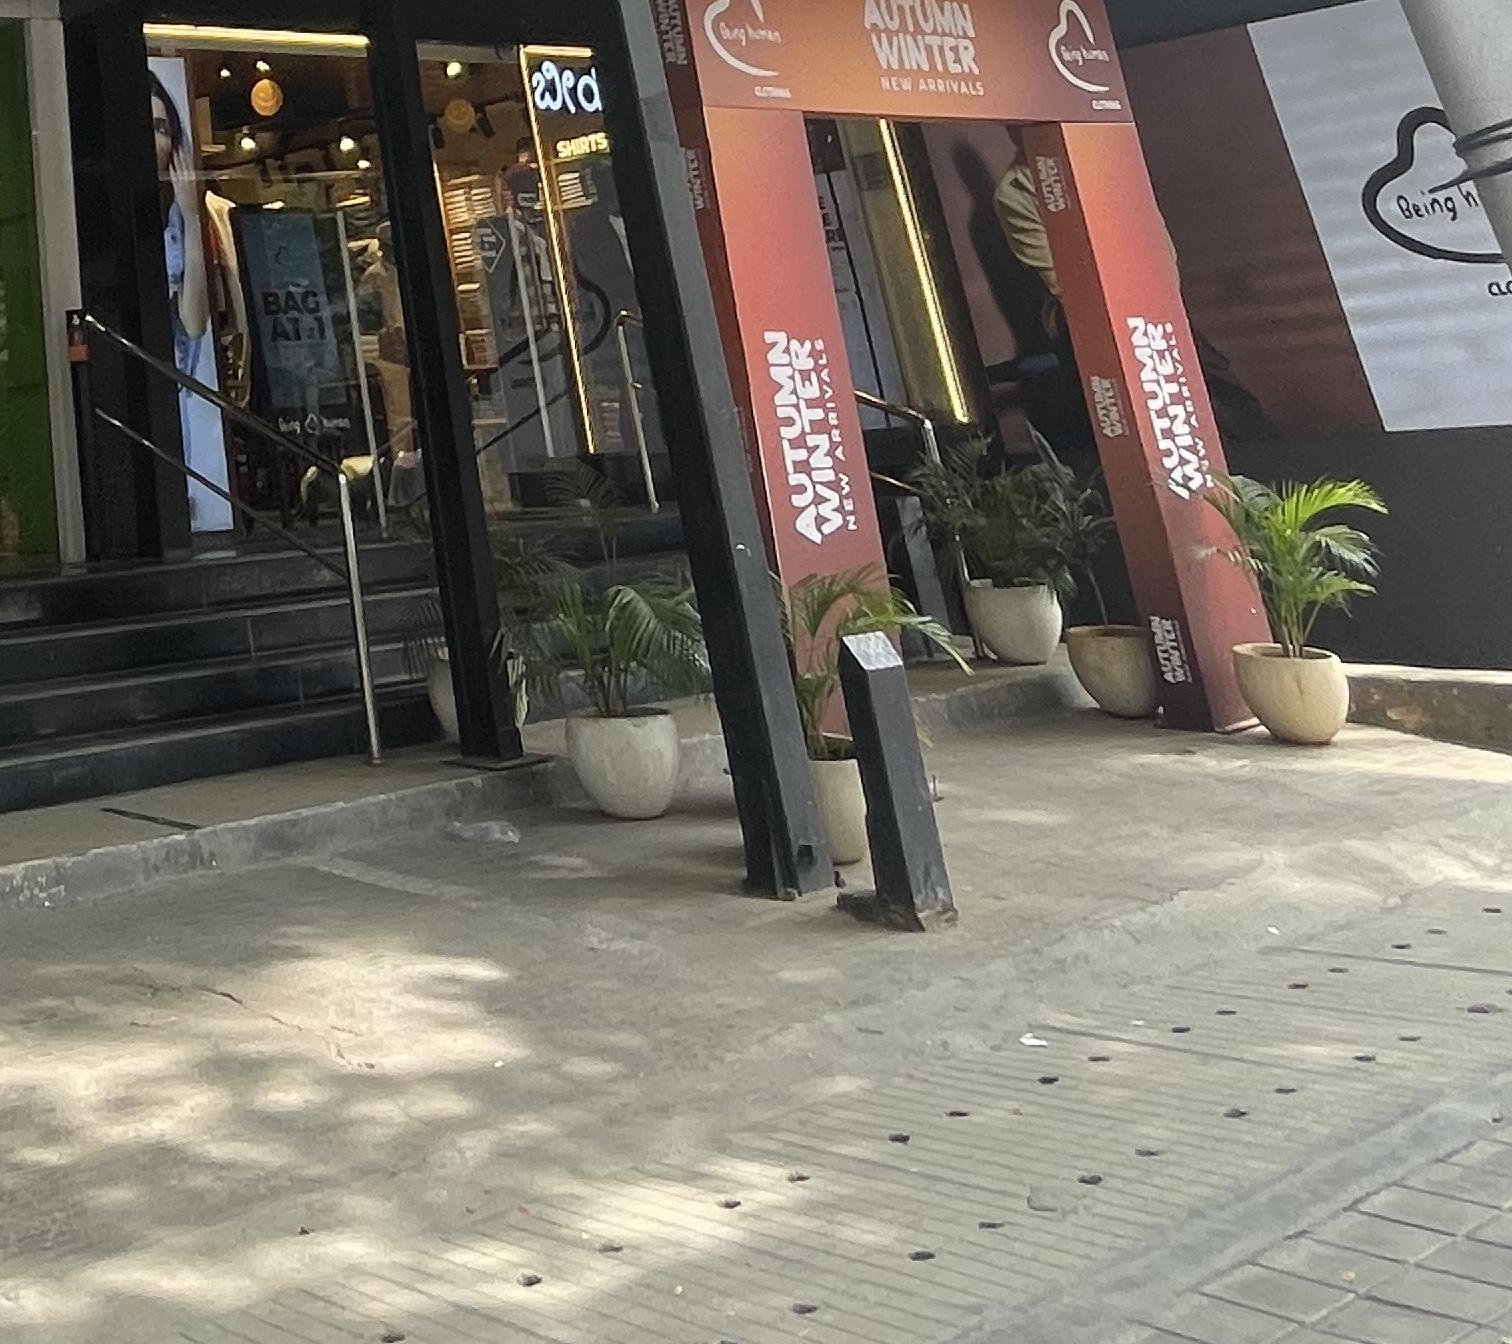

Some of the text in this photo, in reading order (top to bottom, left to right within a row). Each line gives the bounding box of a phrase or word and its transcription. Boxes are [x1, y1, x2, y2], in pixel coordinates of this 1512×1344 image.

[871, 32, 980, 76] WINTER
[879, 76, 985, 96] NEW ARRIVALS
[555, 131, 609, 159] SHIRTS
[261, 290, 320, 316] BAG
[763, 330, 823, 546] AUTUMN
[789, 337, 844, 536] WINTER
[814, 337, 859, 531] NEW ARRIVALS
[1126, 316, 1190, 500] AUTUMN
[1146, 321, 1205, 492] WINTER
